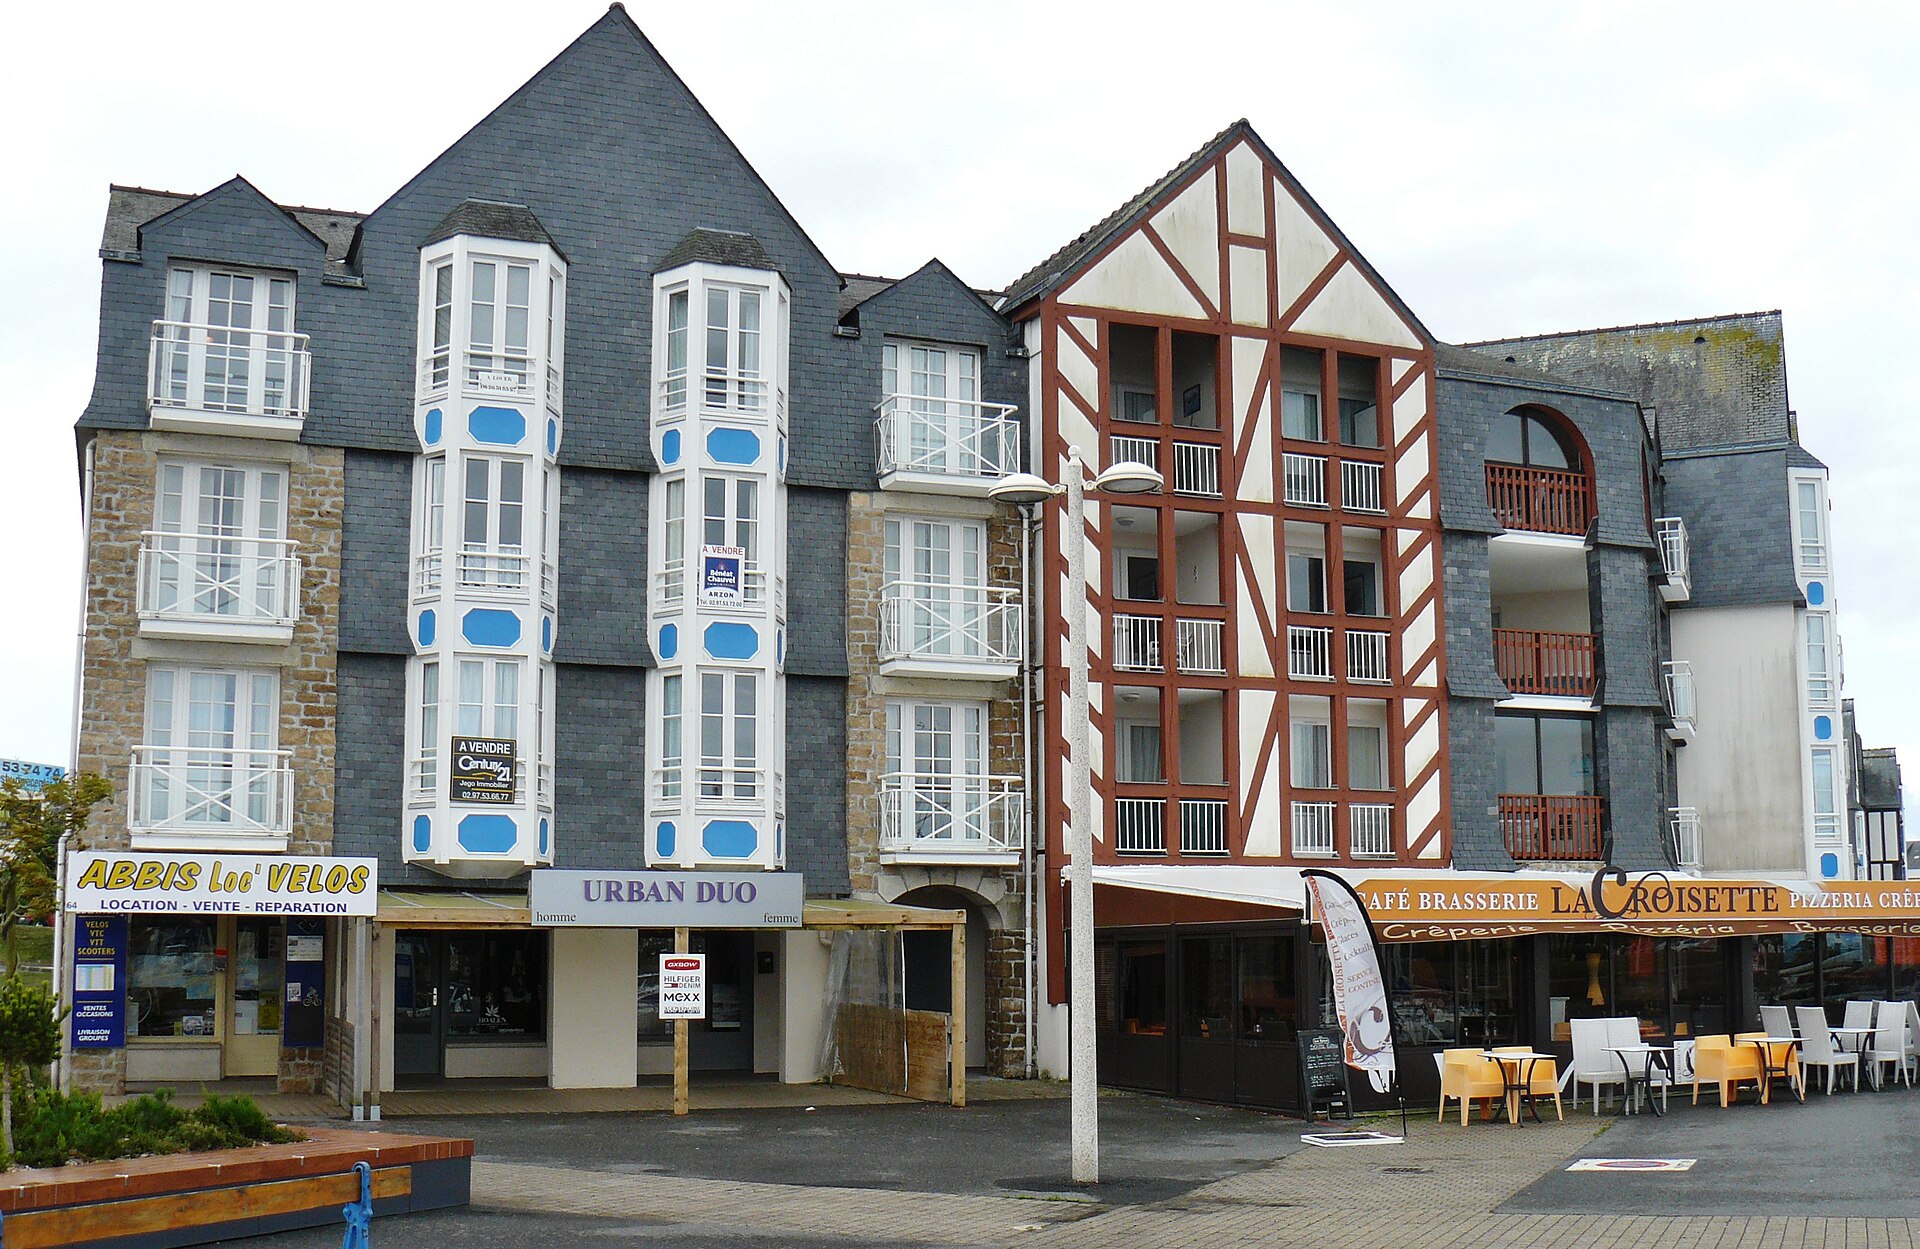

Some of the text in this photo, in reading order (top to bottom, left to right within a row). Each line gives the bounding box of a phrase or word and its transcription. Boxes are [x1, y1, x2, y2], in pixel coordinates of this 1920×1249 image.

[712, 546, 743, 555] VENDRE
[708, 576, 735, 584] Chauvel
[459, 741, 511, 754] A VENDRE
[2, 761, 20, 772] 53
[459, 755, 503, 772] Century
[77, 860, 202, 891] ABBIS
[268, 864, 369, 894] VELOS
[583, 880, 757, 903] URBAN DUO
[1551, 866, 1779, 919] LA CROISETTE
[1789, 891, 1873, 908] PIZZERIA
[100, 899, 178, 911] LOCATION
[193, 901, 240, 912] VENTE
[255, 901, 347, 913] REPARATION
[1418, 892, 1539, 911] BRASSERIE
[536, 912, 577, 923] homme
[763, 913, 799, 924] femme
[1382, 923, 1538, 940] Crêperie
[1599, 922, 1735, 935] Pizzéria
[1347, 967, 1374, 983] SERVICE
